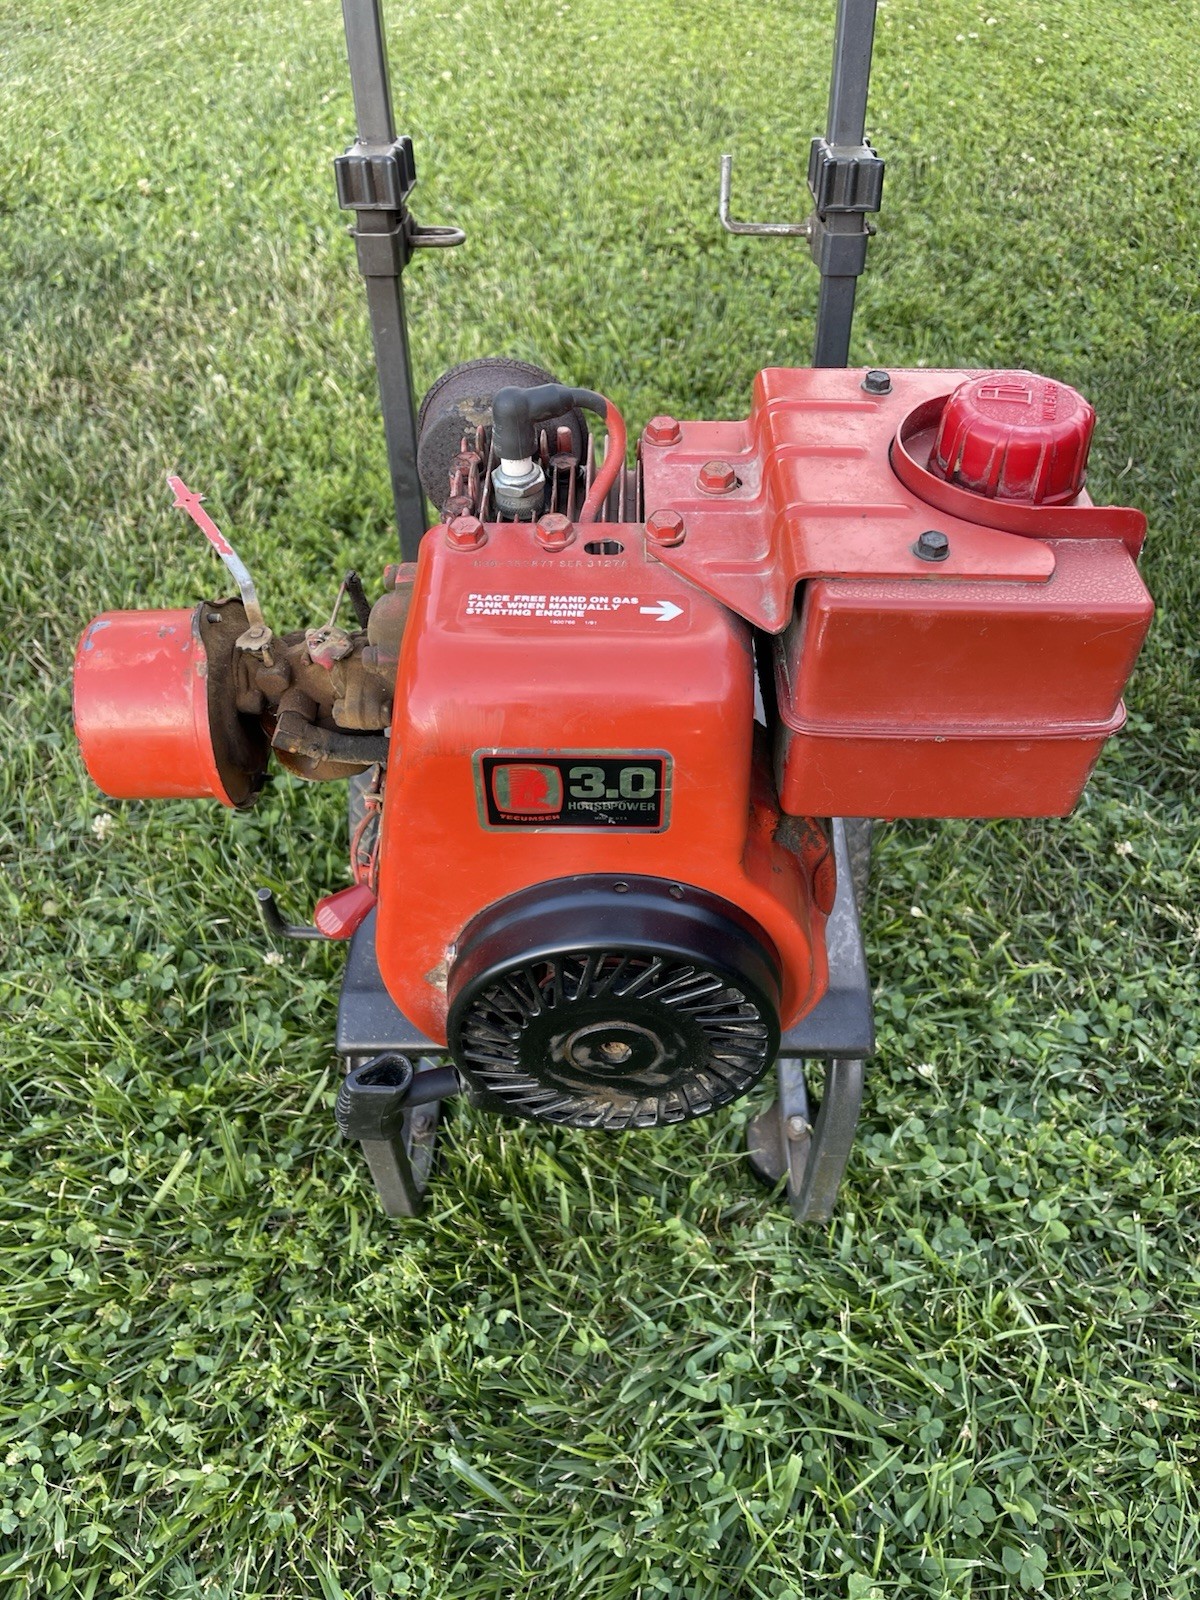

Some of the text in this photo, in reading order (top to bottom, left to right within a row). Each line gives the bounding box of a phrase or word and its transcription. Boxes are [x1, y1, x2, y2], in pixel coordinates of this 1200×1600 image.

[468, 593, 639, 605] PLACE FREE HAND ON GAS
[467, 601, 621, 611] TANK WHEN MANUALLY
[466, 608, 586, 618] STARTING ENGINE
[568, 766, 656, 799] 3.0
[568, 801, 656, 811] HORSEPOWER
[499, 813, 561, 822] TECUMSEH
